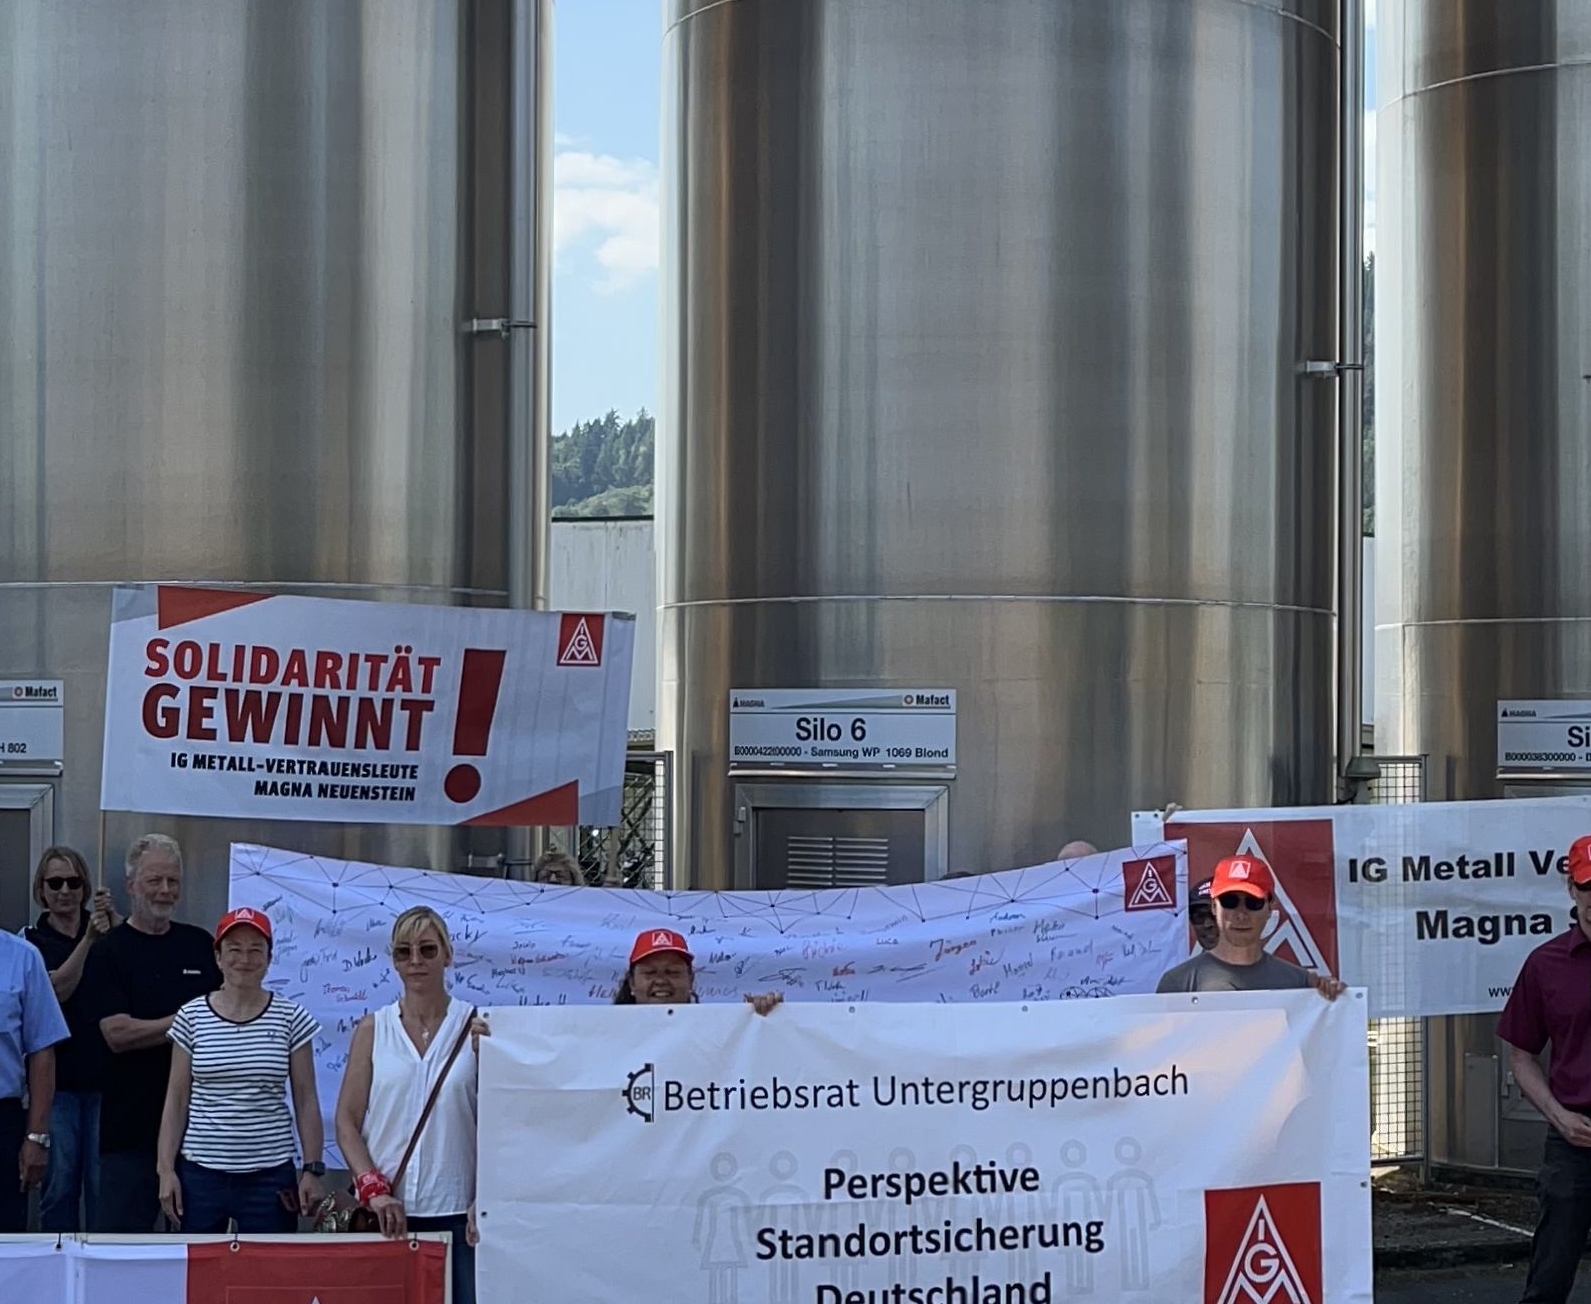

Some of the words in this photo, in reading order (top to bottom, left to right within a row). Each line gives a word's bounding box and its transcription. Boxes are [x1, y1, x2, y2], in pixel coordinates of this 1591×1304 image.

[144, 636, 442, 694] SOLIDARITÄT
[25, 686, 57, 698] Mafact
[915, 695, 950, 706] Mafact
[142, 682, 435, 751] GEWINNT
[795, 717, 842, 742] Silo
[850, 718, 867, 742] 6
[7, 742, 27, 754] 802
[810, 747, 859, 759] Samsung
[861, 747, 880, 758] WP
[886, 748, 912, 758] 1069
[915, 747, 949, 758] Blond
[170, 752, 188, 770] IG
[192, 753, 418, 781] METALL-VERTRAUENSLEUTE
[254, 779, 312, 799] MAGNA
[317, 781, 417, 802] NEUENSTEIN
[1348, 857, 1388, 883] IG
[1401, 851, 1516, 882] Metall
[1415, 908, 1553, 946] Magna
[664, 1075, 860, 1115] Betriebsrat
[873, 1063, 1189, 1114] Untergruppenbach
[823, 1160, 1040, 1205] Perspektive
[755, 1216, 1105, 1264] Standortsicherung
